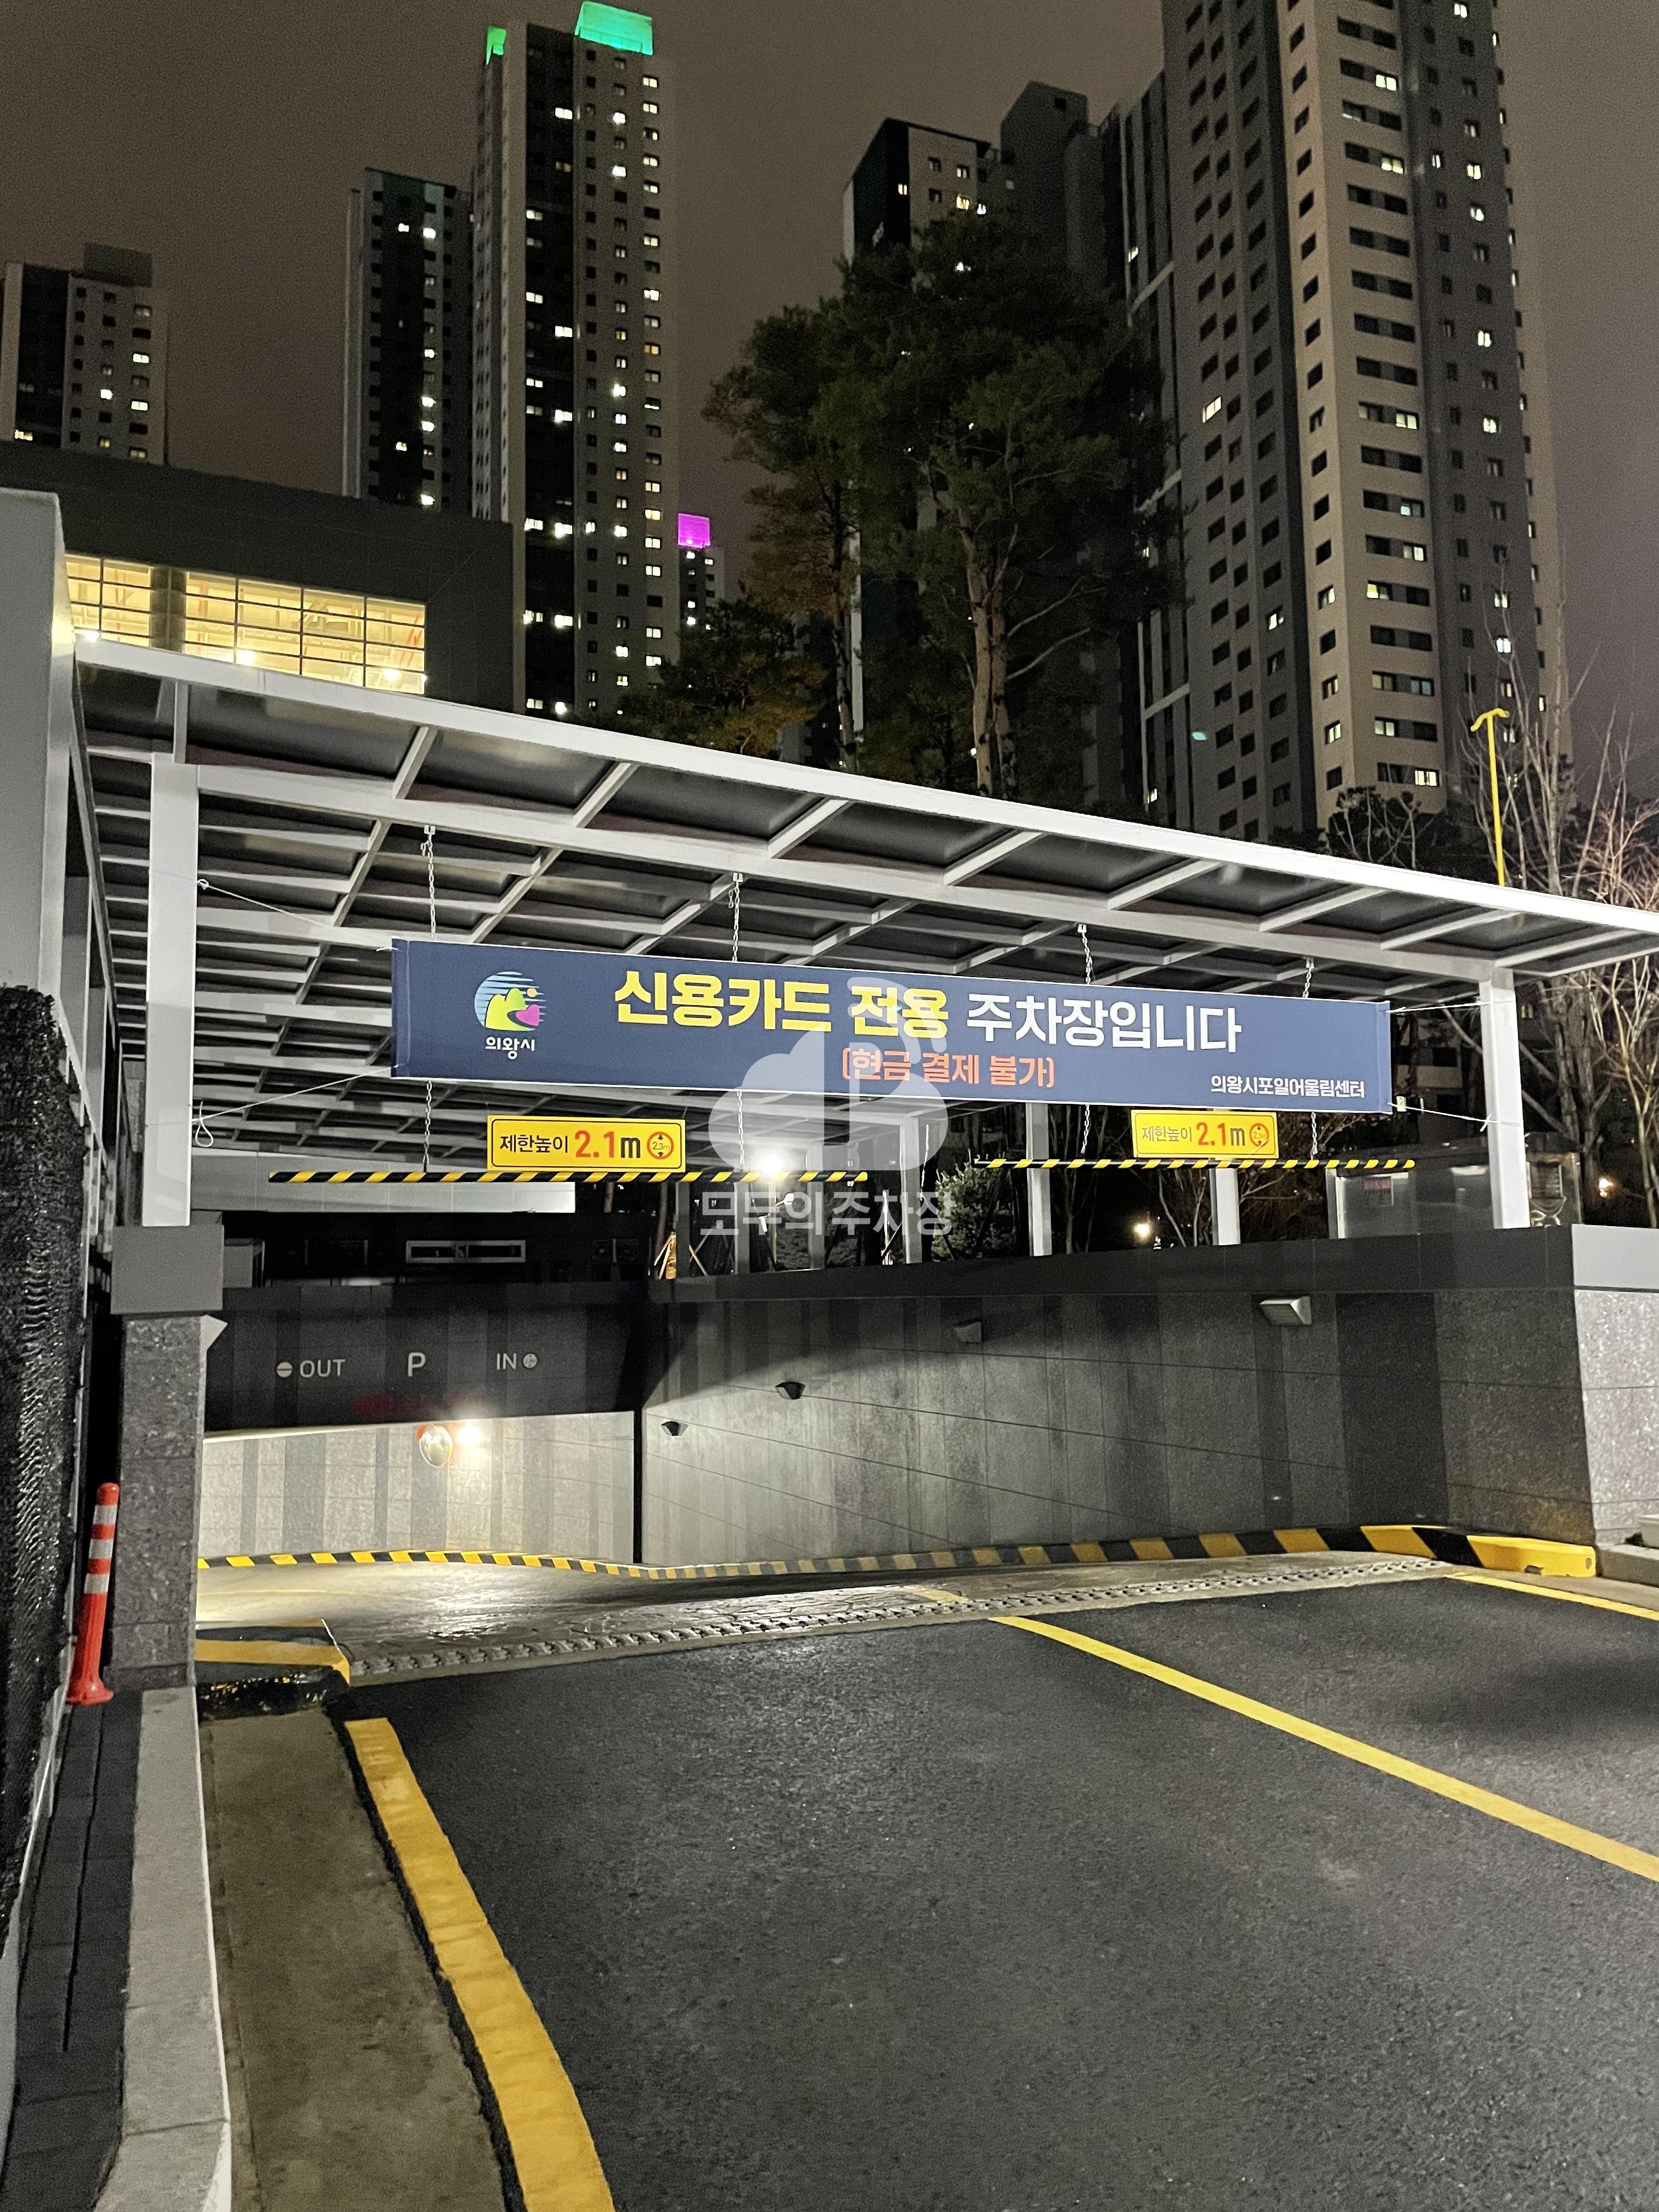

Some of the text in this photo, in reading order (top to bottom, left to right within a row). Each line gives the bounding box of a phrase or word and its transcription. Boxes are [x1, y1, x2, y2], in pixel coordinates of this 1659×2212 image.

[614, 970, 1243, 1053] 신용카드 전용 주차장입니다
[485, 1036, 535, 1060] 의왕시
[922, 1052, 979, 1084] 결제
[1210, 1075, 1365, 1098] 의왕시포일어울림센터
[499, 1130, 641, 1159] 제한높이 2.1m
[1141, 1126, 1193, 1143] 제한높이
[300, 1359, 346, 1378] OUT
[408, 1352, 426, 1377] P
[496, 1353, 517, 1370] IN
